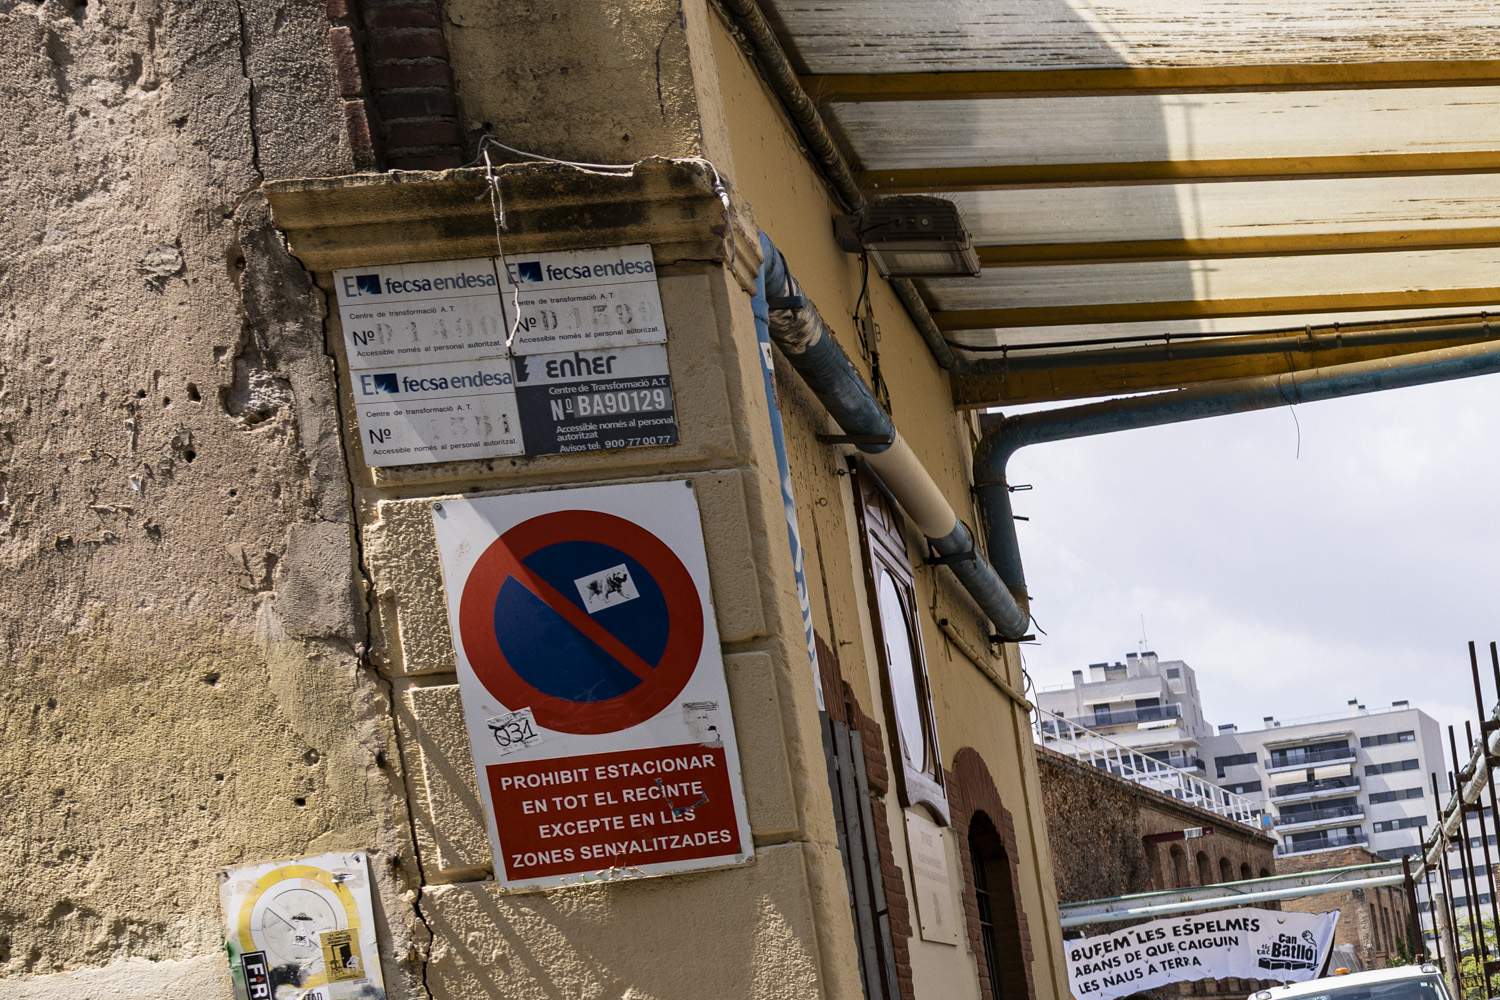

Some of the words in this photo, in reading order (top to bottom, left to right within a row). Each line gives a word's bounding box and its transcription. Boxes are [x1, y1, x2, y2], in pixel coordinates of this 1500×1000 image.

[538, 297, 548, 305] de
[349, 312, 374, 320] Centre
[519, 335, 556, 344] Accessible
[558, 332, 582, 341] només
[593, 329, 624, 339] personal
[356, 348, 395, 359] Accessible
[397, 346, 421, 355] només
[433, 343, 465, 353] personal
[546, 351, 618, 379] enher
[549, 386, 578, 396] Centre
[578, 383, 589, 393] de
[590, 377, 650, 392] Transformació
[577, 388, 667, 417] BA90129
[366, 410, 391, 419] Centre
[556, 421, 598, 434] Accessible
[599, 420, 628, 431] només
[628, 417, 637, 427] al
[638, 415, 675, 430] personal
[556, 431, 599, 442] autoritzat
[559, 442, 588, 453] Avisos
[604, 438, 625, 449] 900
[372, 447, 412, 456] Accessible
[414, 444, 438, 453] només
[450, 440, 481, 451] personal
[501, 767, 590, 791] PROHIBIT
[595, 754, 717, 781] ESTACIONAR
[522, 798, 548, 815] EN
[552, 794, 589, 811] TOT
[595, 792, 619, 807] EL
[622, 780, 704, 804] RECINTE
[539, 814, 625, 839] EXCEPTE
[630, 812, 656, 828] EN
[660, 808, 697, 825] LES
[512, 848, 576, 869] ZONES
[579, 829, 732, 859] SENYALITZADES
[1070, 935, 1132, 962] BUFEM
[1136, 927, 1166, 945] LES
[1172, 917, 1261, 937] ESPELMES
[1278, 933, 1298, 945] Can
[1075, 955, 1122, 978] ABANS
[1125, 950, 1142, 965] DE
[1146, 942, 1175, 957] QUE
[1178, 936, 1240, 951] CAIGUIN
[1271, 941, 1314, 961] Batlló
[1078, 981, 1100, 996] LES
[1104, 967, 1144, 989] NAUS
[1147, 964, 1159, 976] A
[1160, 956, 1202, 972] TERRA
